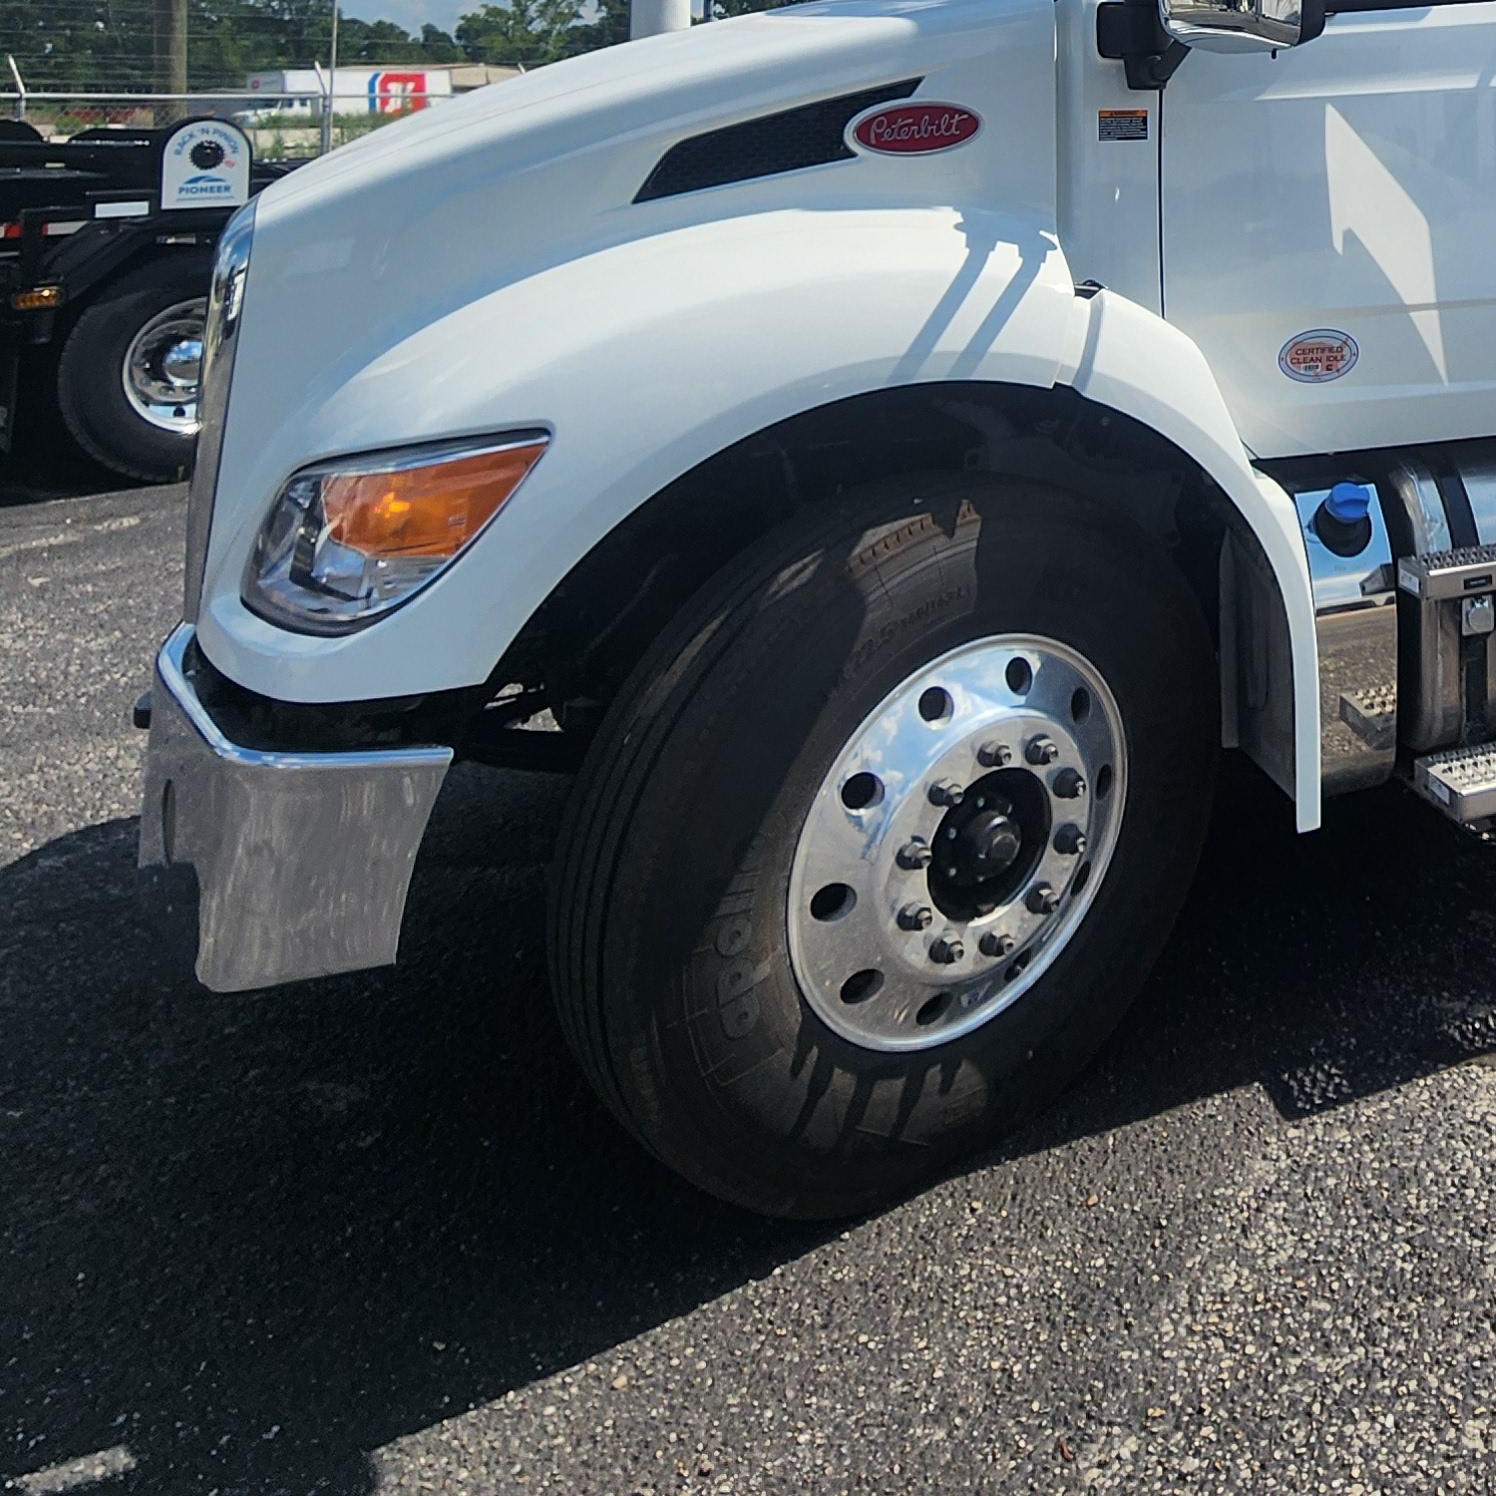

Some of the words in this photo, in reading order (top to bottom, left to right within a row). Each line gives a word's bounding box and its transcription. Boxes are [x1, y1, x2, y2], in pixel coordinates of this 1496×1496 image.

[869, 113, 969, 145] Peterbilt
[178, 184, 231, 195] PIONEER
[1295, 346, 1345, 356] CERTIFIED
[1290, 356, 1322, 365] CLEAN
[1326, 354, 1346, 363] IDLE
